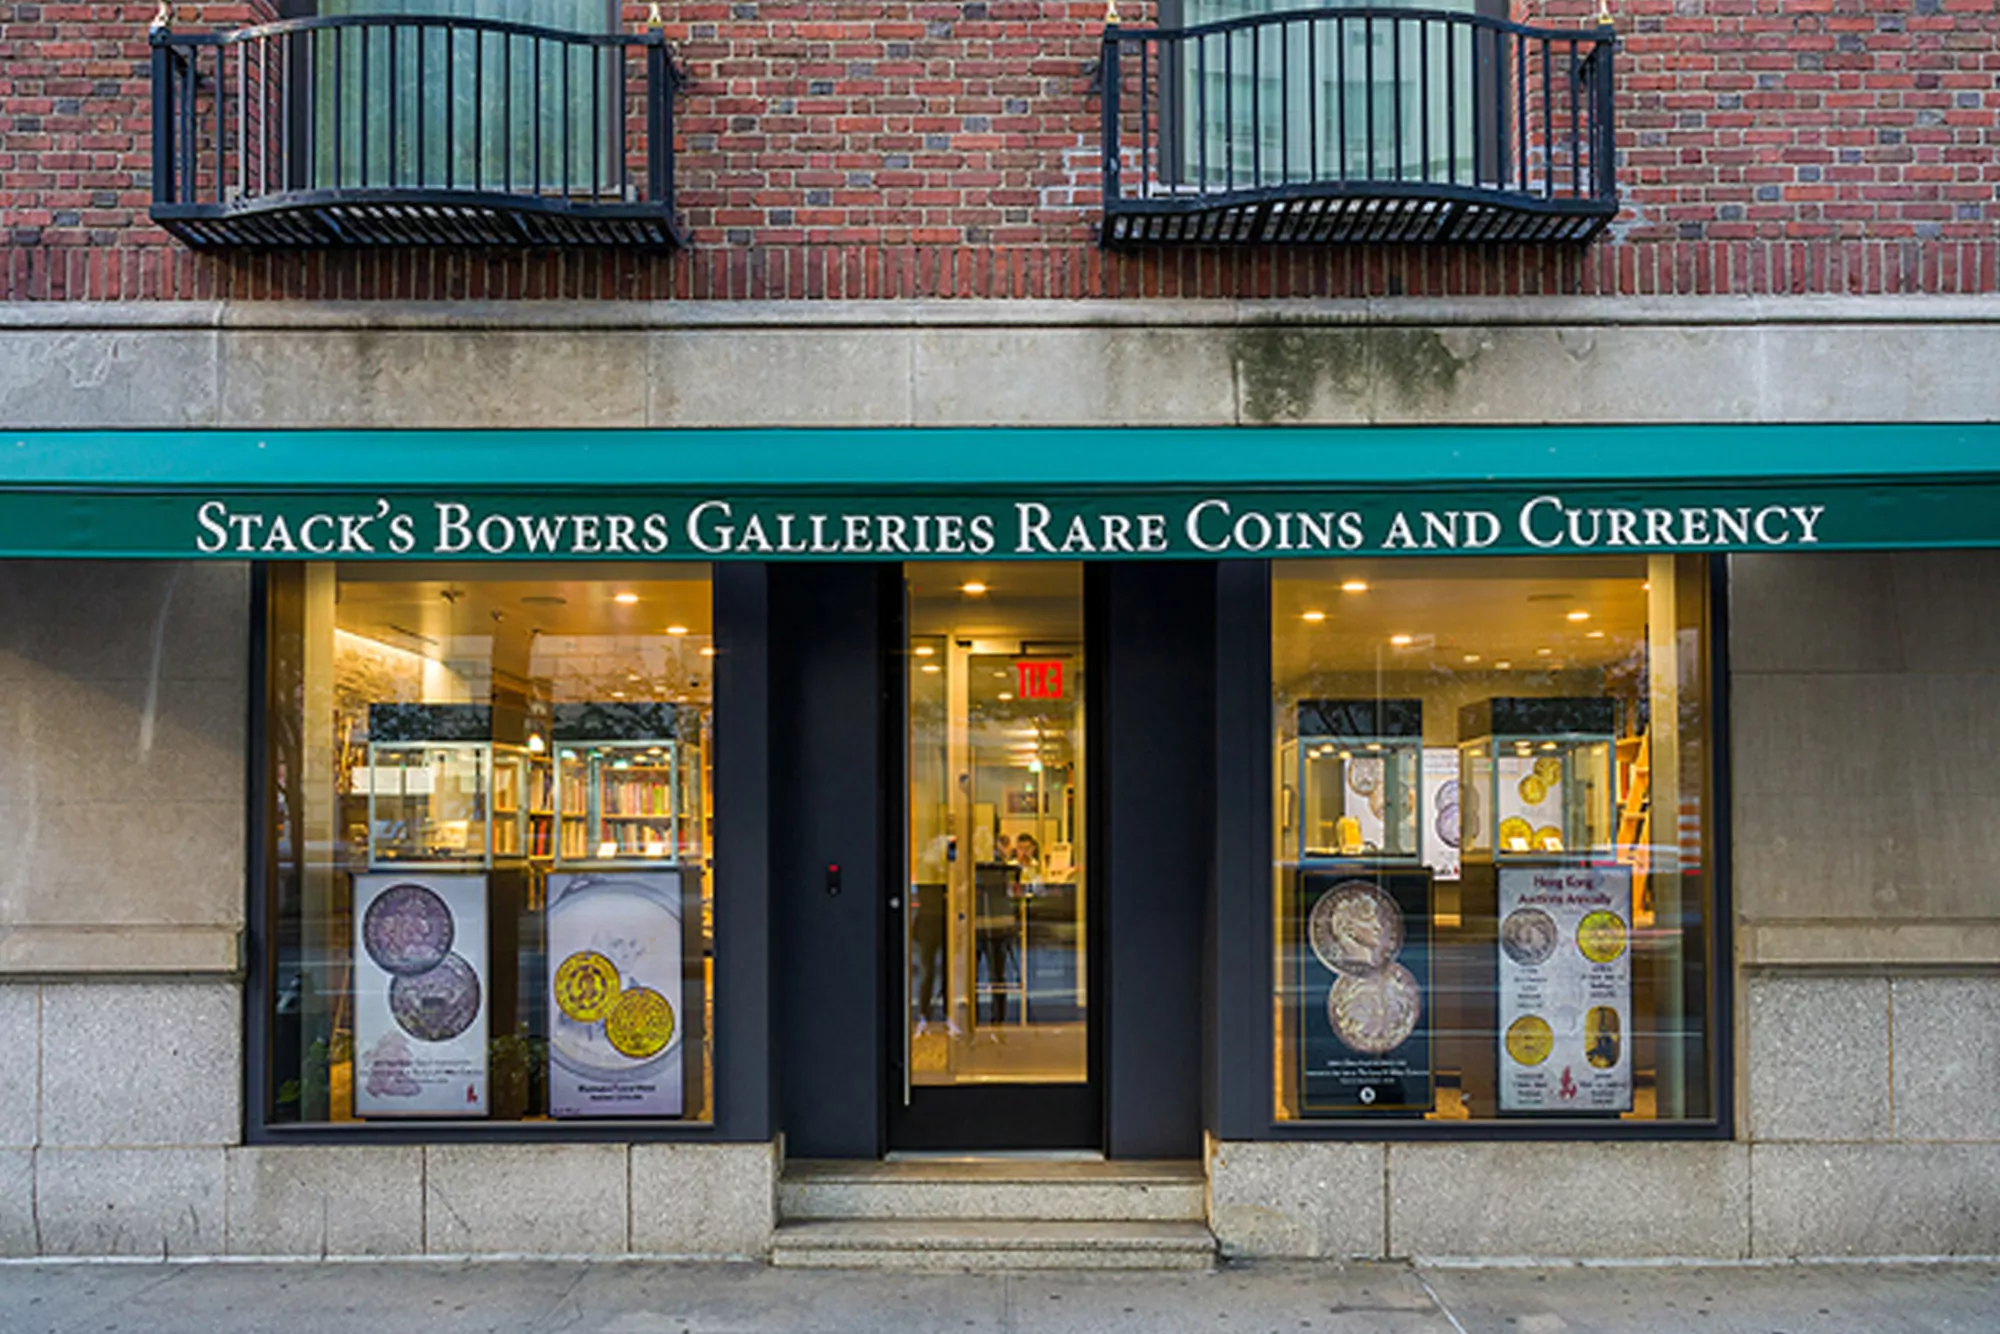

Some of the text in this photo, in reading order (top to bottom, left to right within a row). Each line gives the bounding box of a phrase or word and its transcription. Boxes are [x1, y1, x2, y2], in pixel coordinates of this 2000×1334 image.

[1381, 511, 1501, 550] AND
[1533, 875, 1594, 890] Hong Kong
